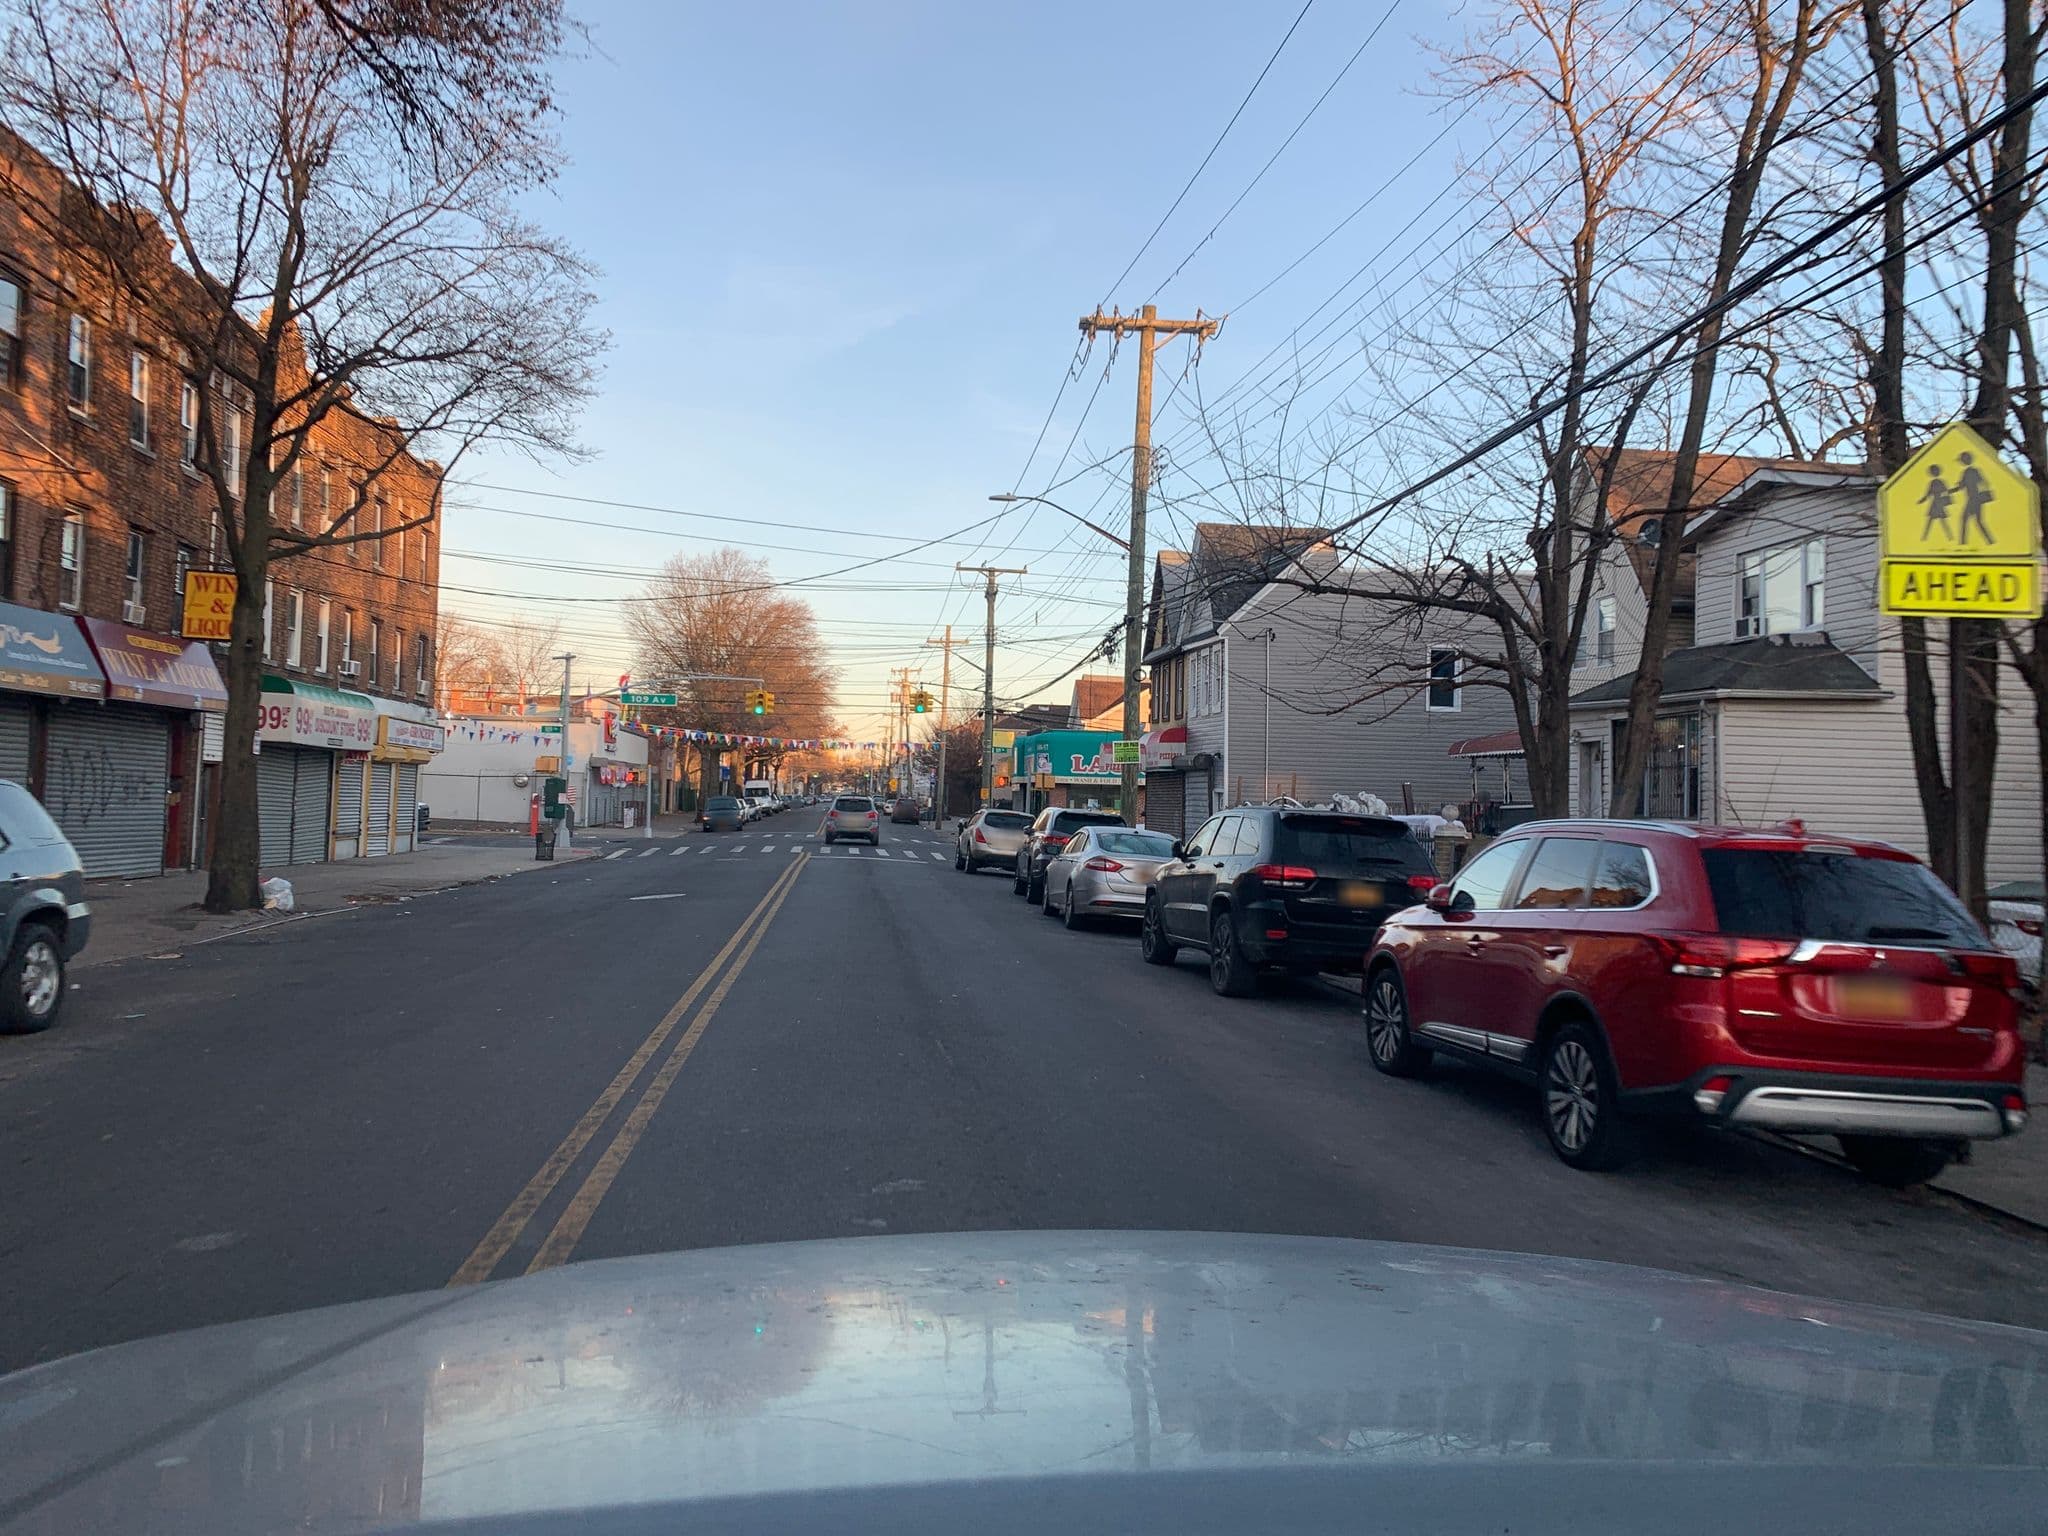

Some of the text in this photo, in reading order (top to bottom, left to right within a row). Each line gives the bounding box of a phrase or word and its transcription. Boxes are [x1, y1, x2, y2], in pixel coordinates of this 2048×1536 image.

[193, 575, 237, 593] WIN
[1901, 571, 2021, 602] AHEAD
[210, 598, 230, 614] &
[100, 647, 155, 681] WINE
[151, 658, 169, 683] &
[631, 695, 667, 704] 109 Av
